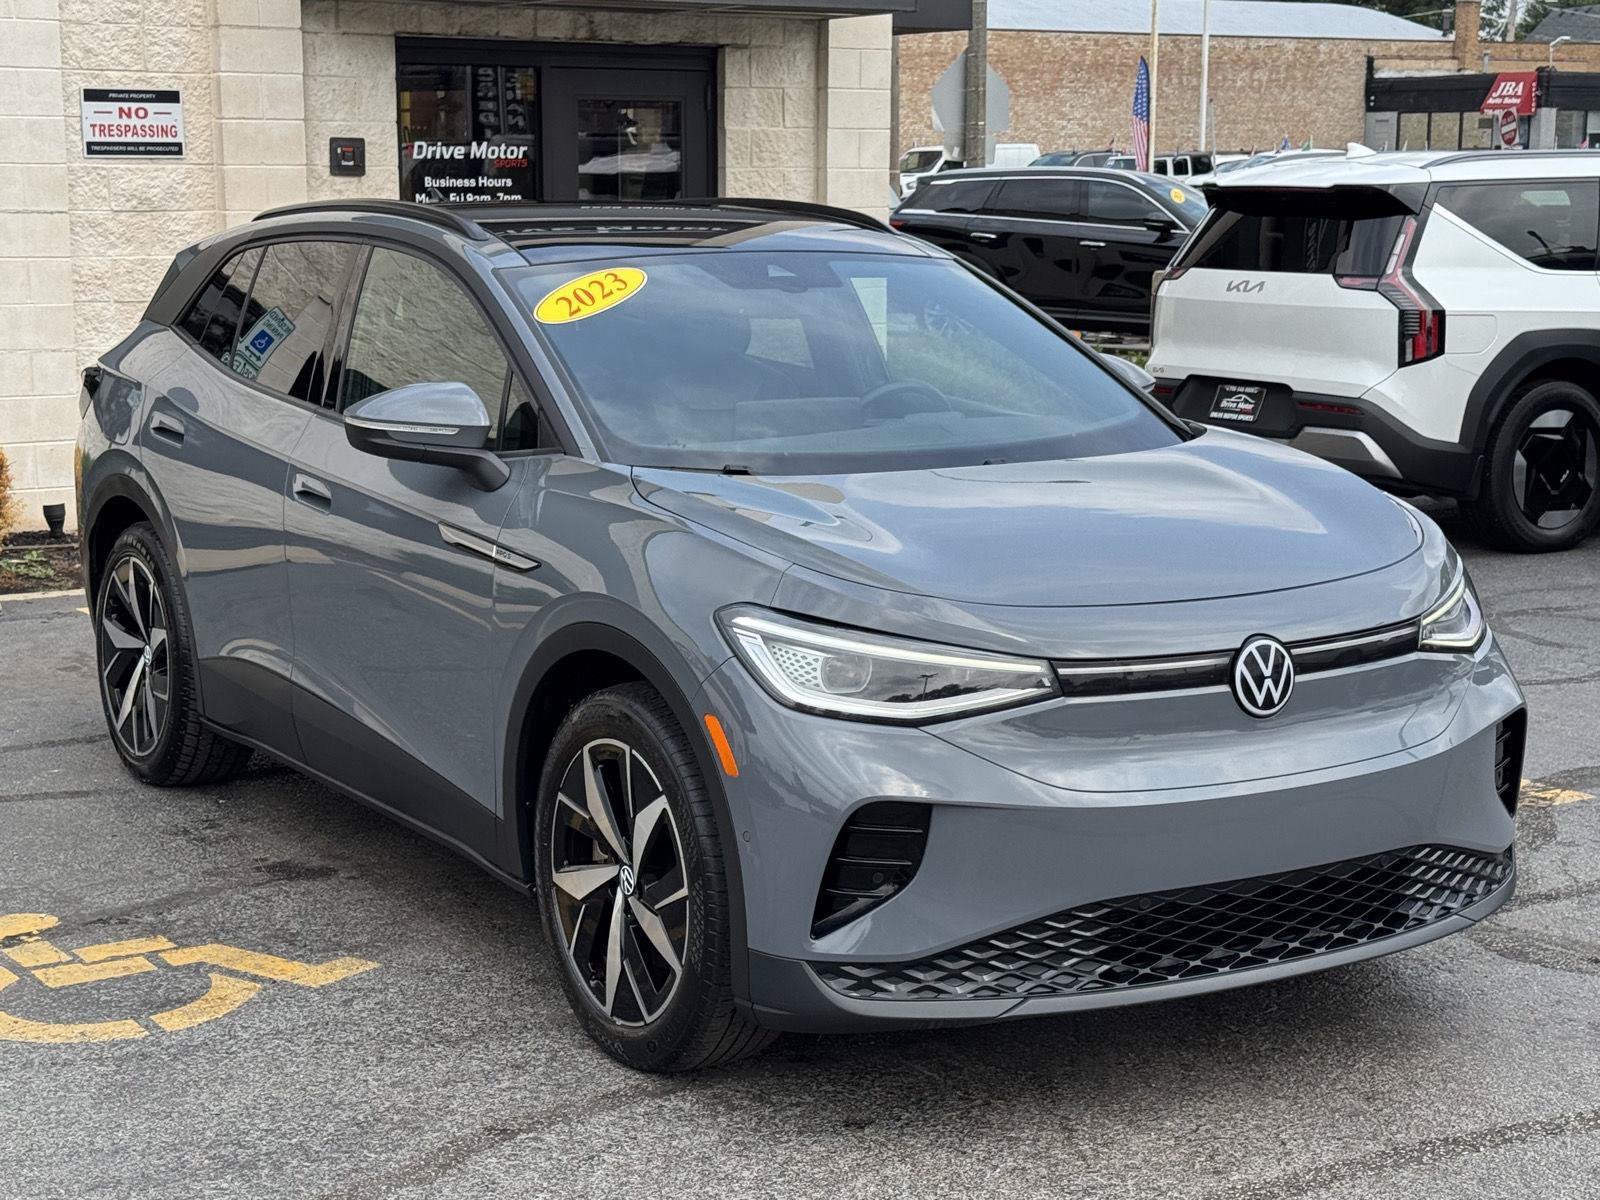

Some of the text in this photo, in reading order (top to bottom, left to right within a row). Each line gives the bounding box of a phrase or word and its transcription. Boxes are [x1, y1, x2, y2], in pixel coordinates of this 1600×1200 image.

[1492, 81, 1524, 97] JBA
[118, 106, 149, 119] NO
[90, 124, 178, 138] TRESPASSING
[412, 141, 528, 160] Drive Motor
[494, 159, 528, 168] SPORTS
[424, 176, 513, 188] Business Hours
[556, 273, 627, 317] 2023
[1235, 640, 1294, 715] VW
